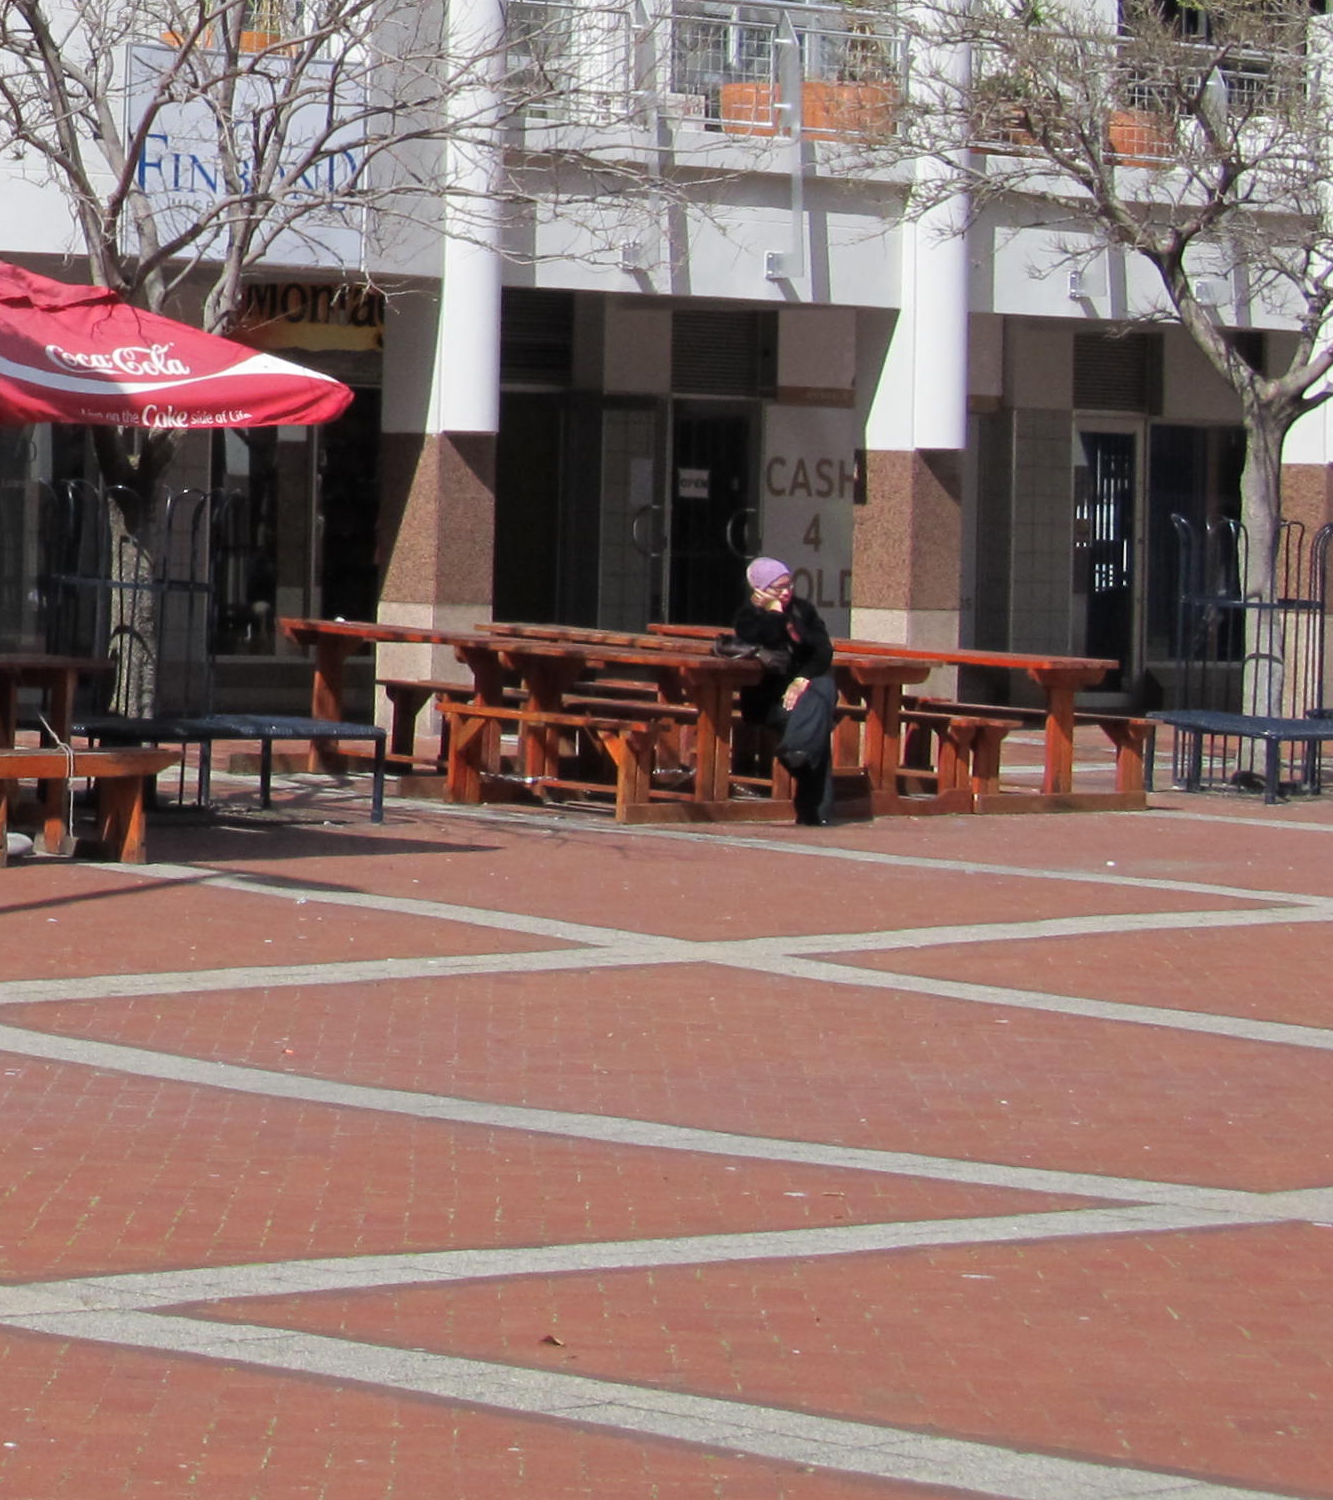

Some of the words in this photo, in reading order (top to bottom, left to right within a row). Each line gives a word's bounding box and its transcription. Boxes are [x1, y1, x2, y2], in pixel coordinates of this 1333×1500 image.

[137, 133, 359, 211] FINBND
[44, 343, 190, 376] Coca-Cola
[121, 409, 140, 424] the
[141, 404, 189, 428] Coke
[190, 411, 214, 425] side
[214, 410, 229, 424] of
[766, 455, 857, 499] CASH
[802, 513, 822, 552] 4
[789, 567, 852, 609] OLD
